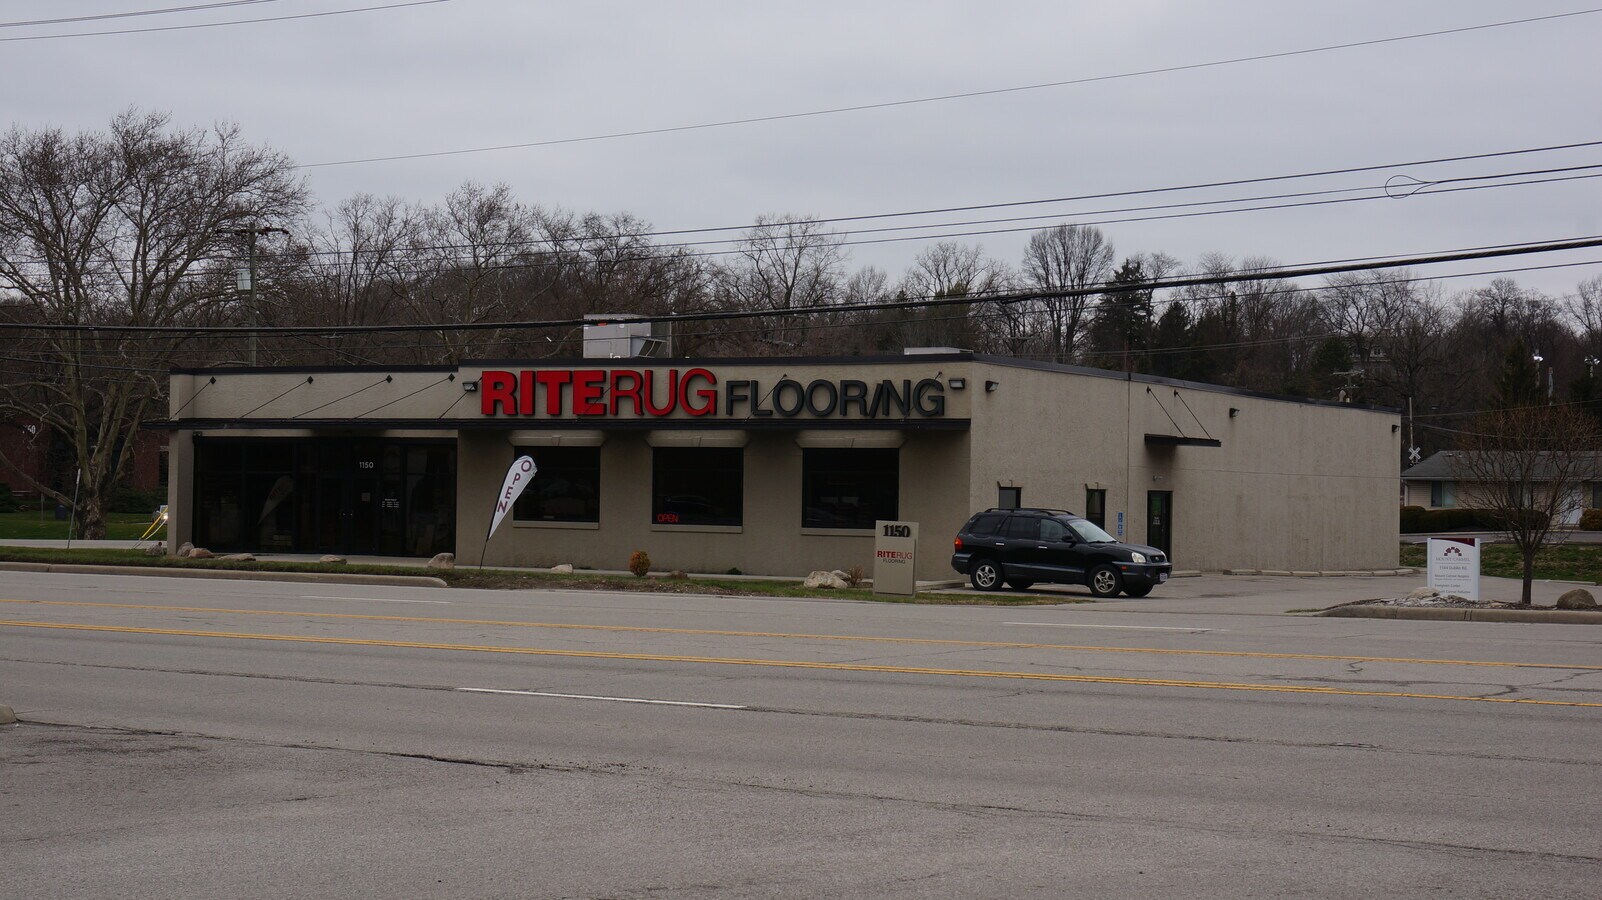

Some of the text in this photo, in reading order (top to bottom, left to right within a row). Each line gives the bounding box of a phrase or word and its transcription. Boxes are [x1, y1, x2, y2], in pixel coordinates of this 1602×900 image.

[481, 368, 945, 418] RITERUG FLOORING
[359, 461, 374, 469] 1150
[497, 460, 532, 513] OPEN
[657, 513, 679, 522] OPEN
[883, 524, 911, 537] 1150
[877, 550, 912, 560] RITERUG
